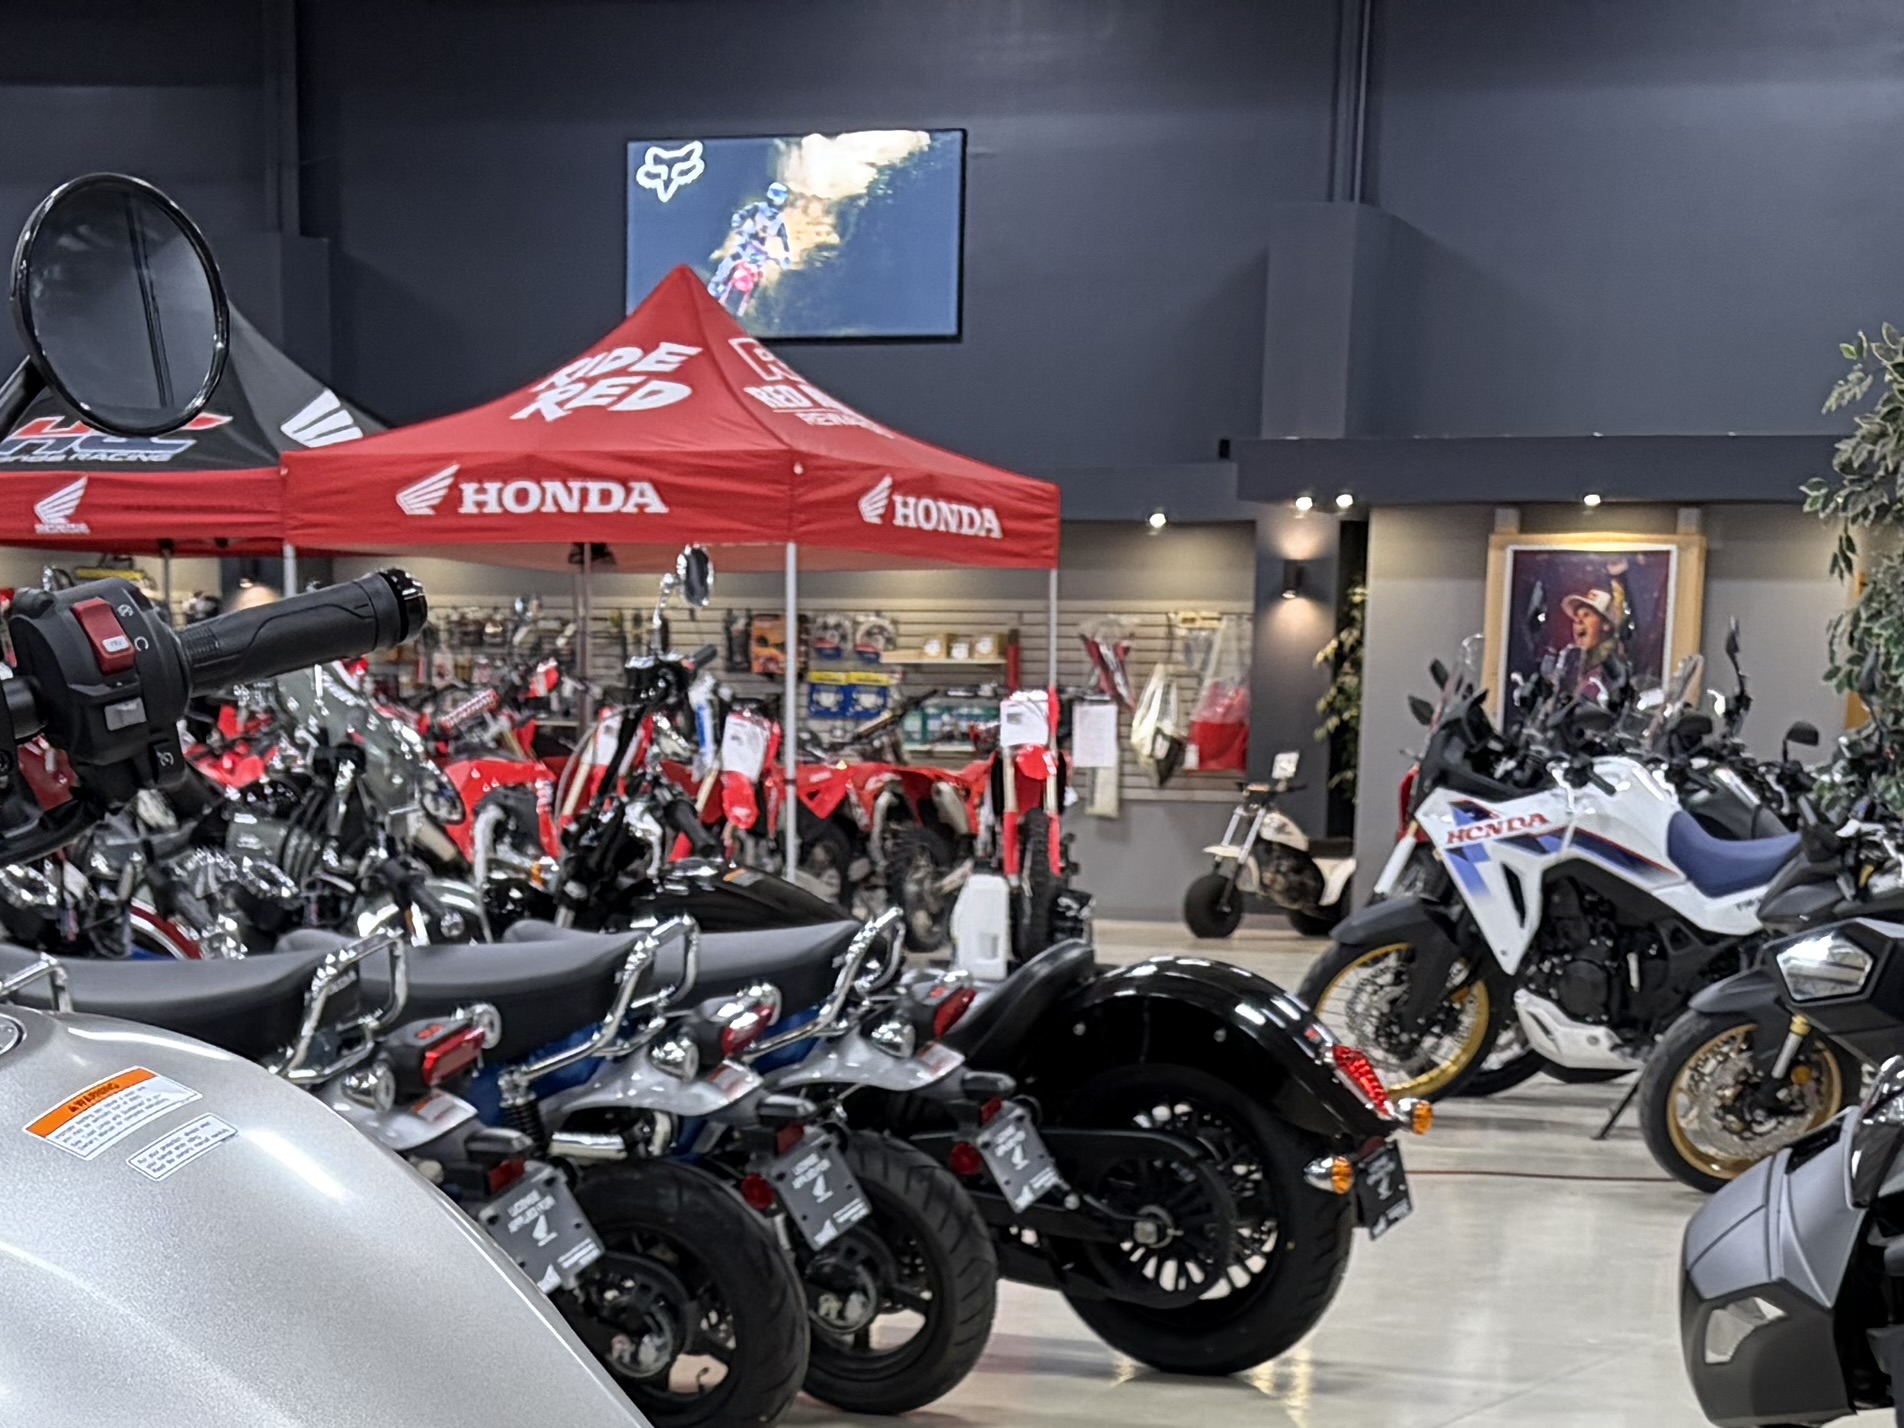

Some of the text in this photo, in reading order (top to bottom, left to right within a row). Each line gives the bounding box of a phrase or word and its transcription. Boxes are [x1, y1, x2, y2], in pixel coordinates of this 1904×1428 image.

[531, 342, 703, 392] RIDE
[509, 376, 693, 421] RED
[458, 480, 670, 514] HONDA
[892, 494, 1003, 539] HONDA
